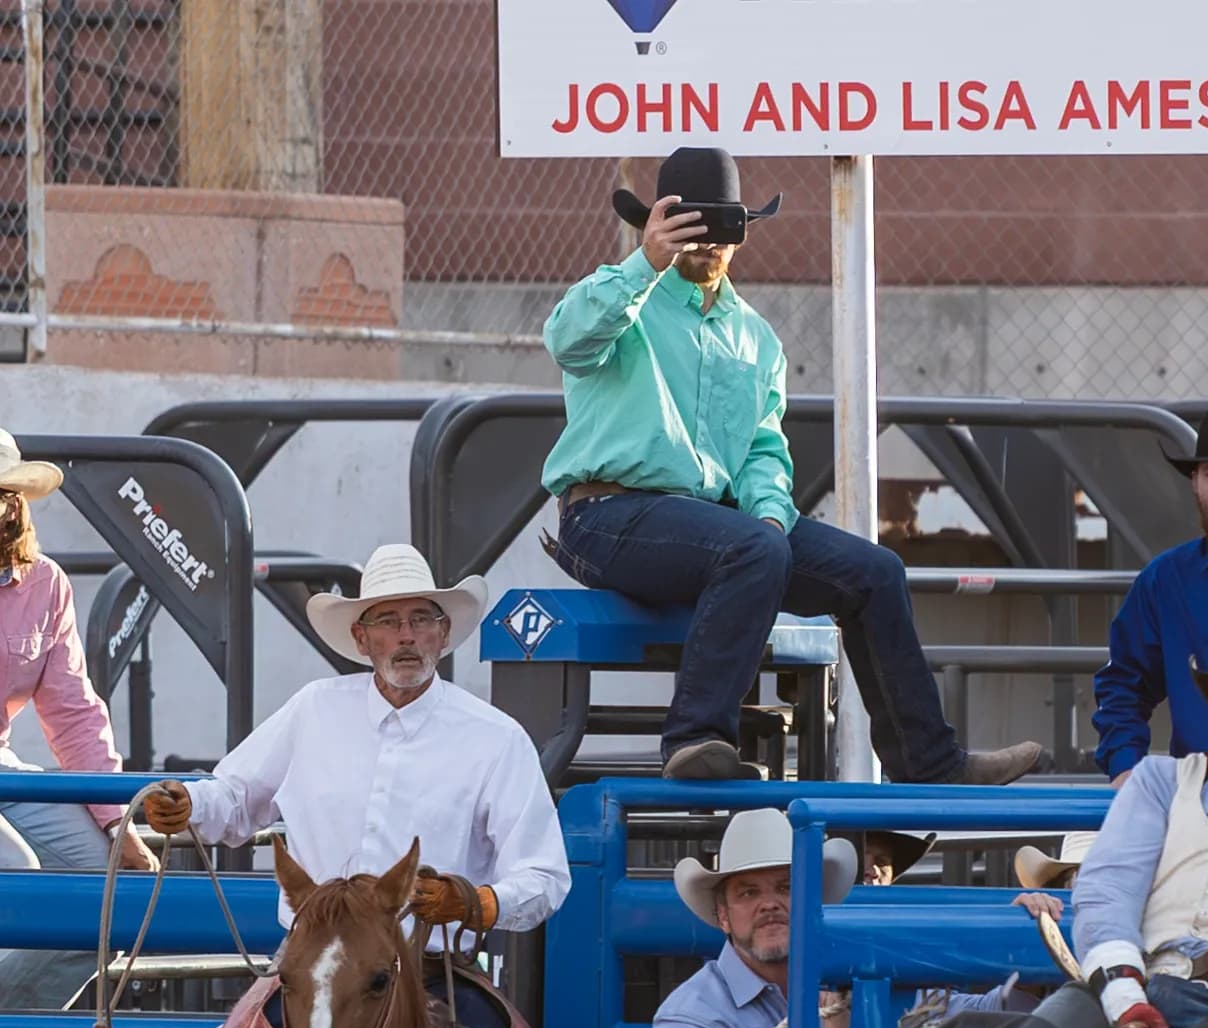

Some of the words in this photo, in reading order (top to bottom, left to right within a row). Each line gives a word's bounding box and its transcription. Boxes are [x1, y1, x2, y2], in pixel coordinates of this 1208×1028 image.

[552, 82, 720, 133] JOHN
[742, 81, 878, 132] AND
[901, 80, 1037, 131] LISA
[117, 476, 208, 584] Priefert
